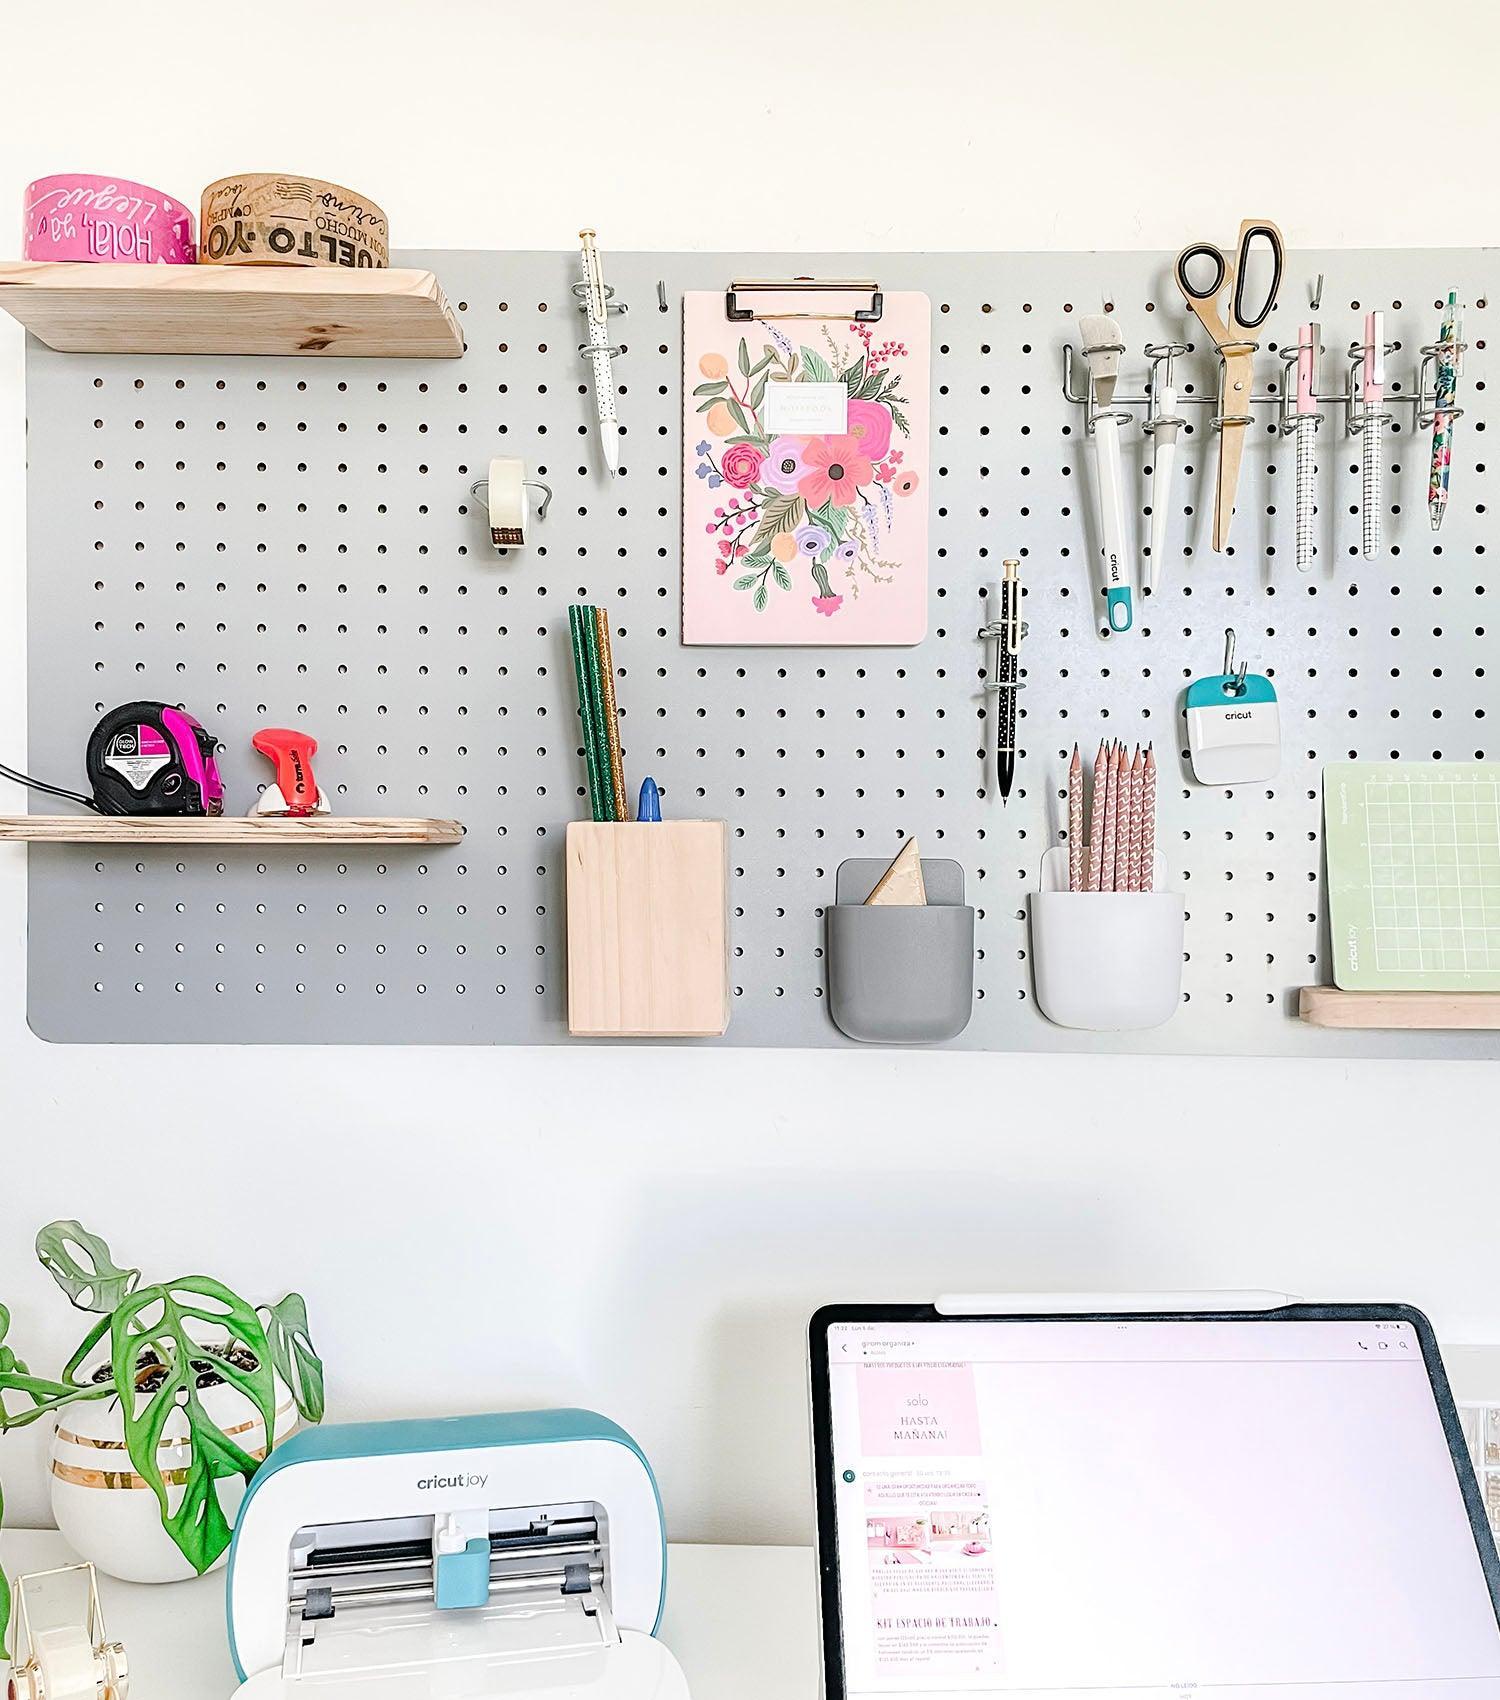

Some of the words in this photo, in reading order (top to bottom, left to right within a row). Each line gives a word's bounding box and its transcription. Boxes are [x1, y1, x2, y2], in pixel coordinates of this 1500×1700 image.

[315, 217, 366, 246] MUCHO
[1110, 553, 1120, 582] cricut
[1225, 711, 1252, 720] cricut
[1347, 939, 1359, 972] cricut
[906, 1393, 929, 1406] solo
[900, 1416, 938, 1426] HASTA
[417, 1474, 464, 1490] cricut
[466, 1472, 489, 1488] joy
[877, 1618, 893, 1629] KIT
[896, 1618, 932, 1629] ESPACIO
[935, 1617, 947, 1628] DE
[949, 1616, 991, 1628] TRABAJO
